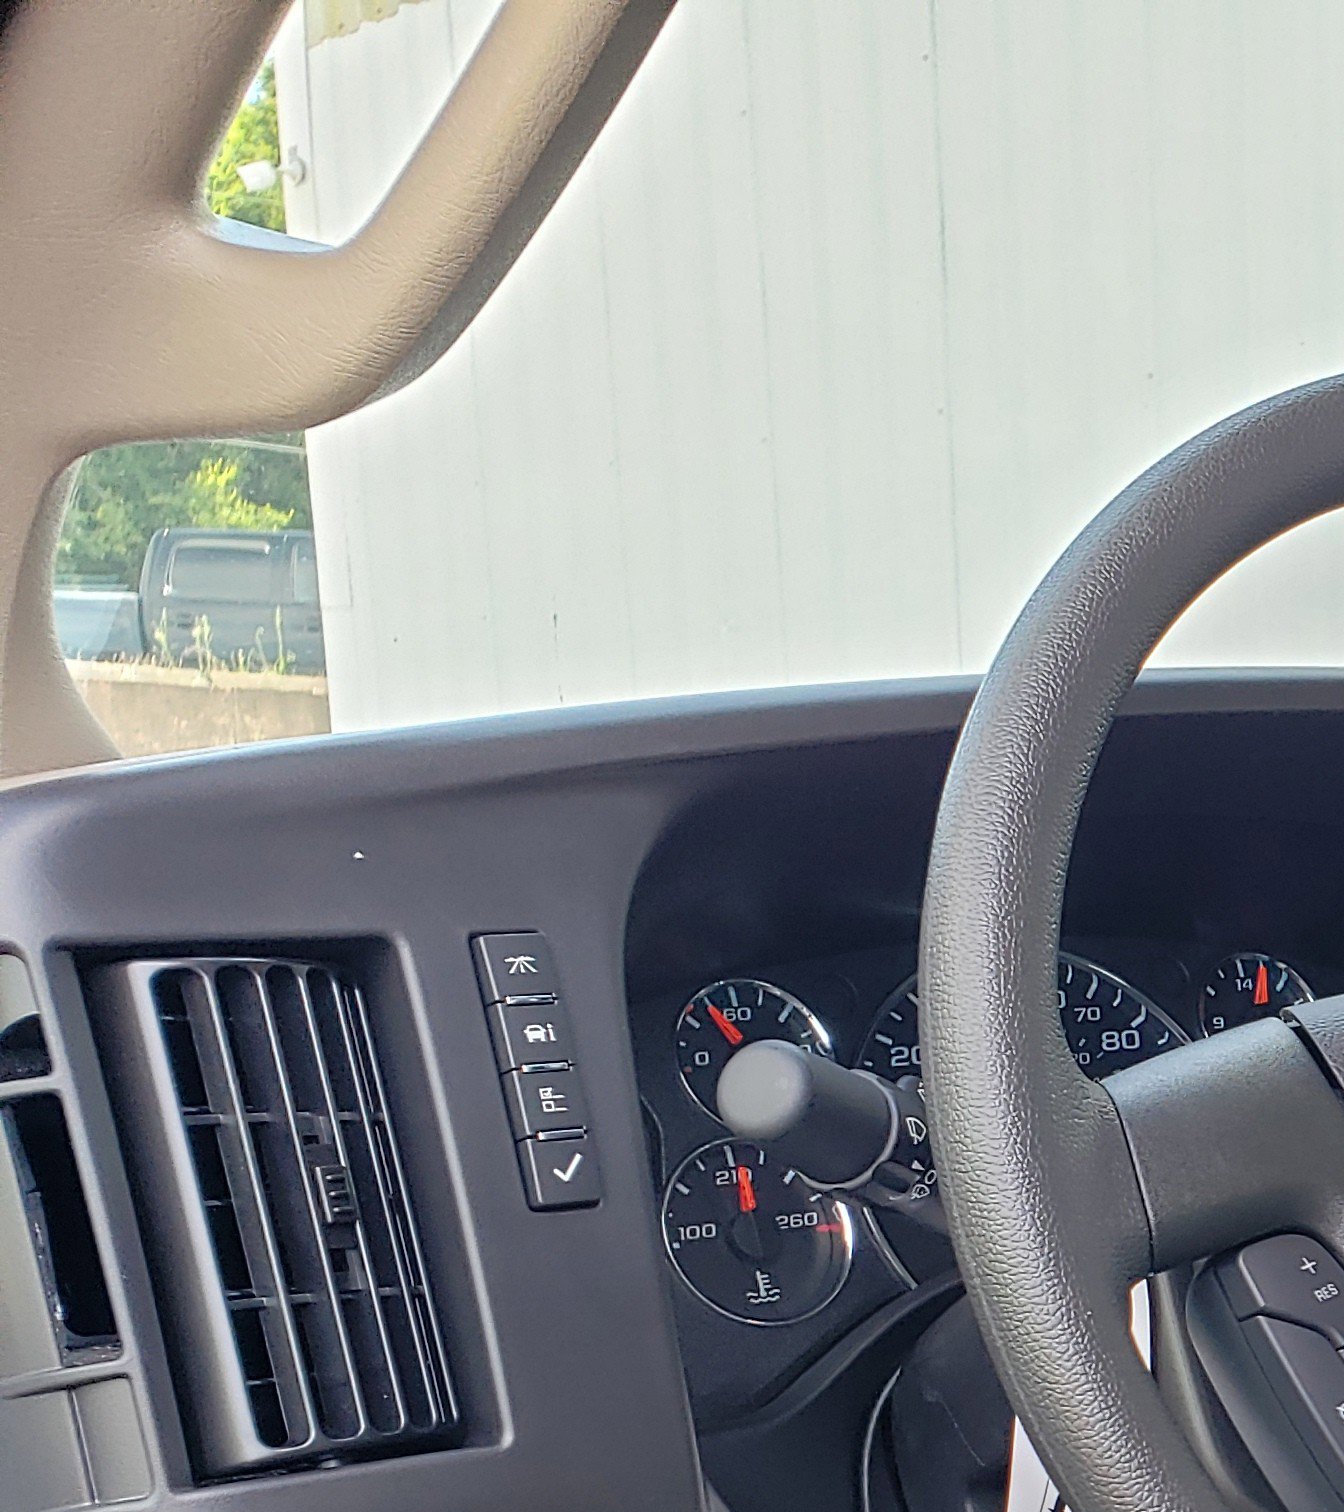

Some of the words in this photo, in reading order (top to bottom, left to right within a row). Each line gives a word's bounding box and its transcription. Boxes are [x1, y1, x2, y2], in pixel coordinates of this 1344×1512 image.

[1235, 977, 1253, 991] 14
[723, 1006, 751, 1022] 60
[1074, 1006, 1101, 1022] 70
[1212, 1016, 1225, 1029] 9
[1101, 1029, 1141, 1052] 80
[694, 1051, 709, 1066] 0
[775, 1211, 819, 1229] 260
[678, 1223, 717, 1241] 100
[1314, 1283, 1339, 1303] RES
